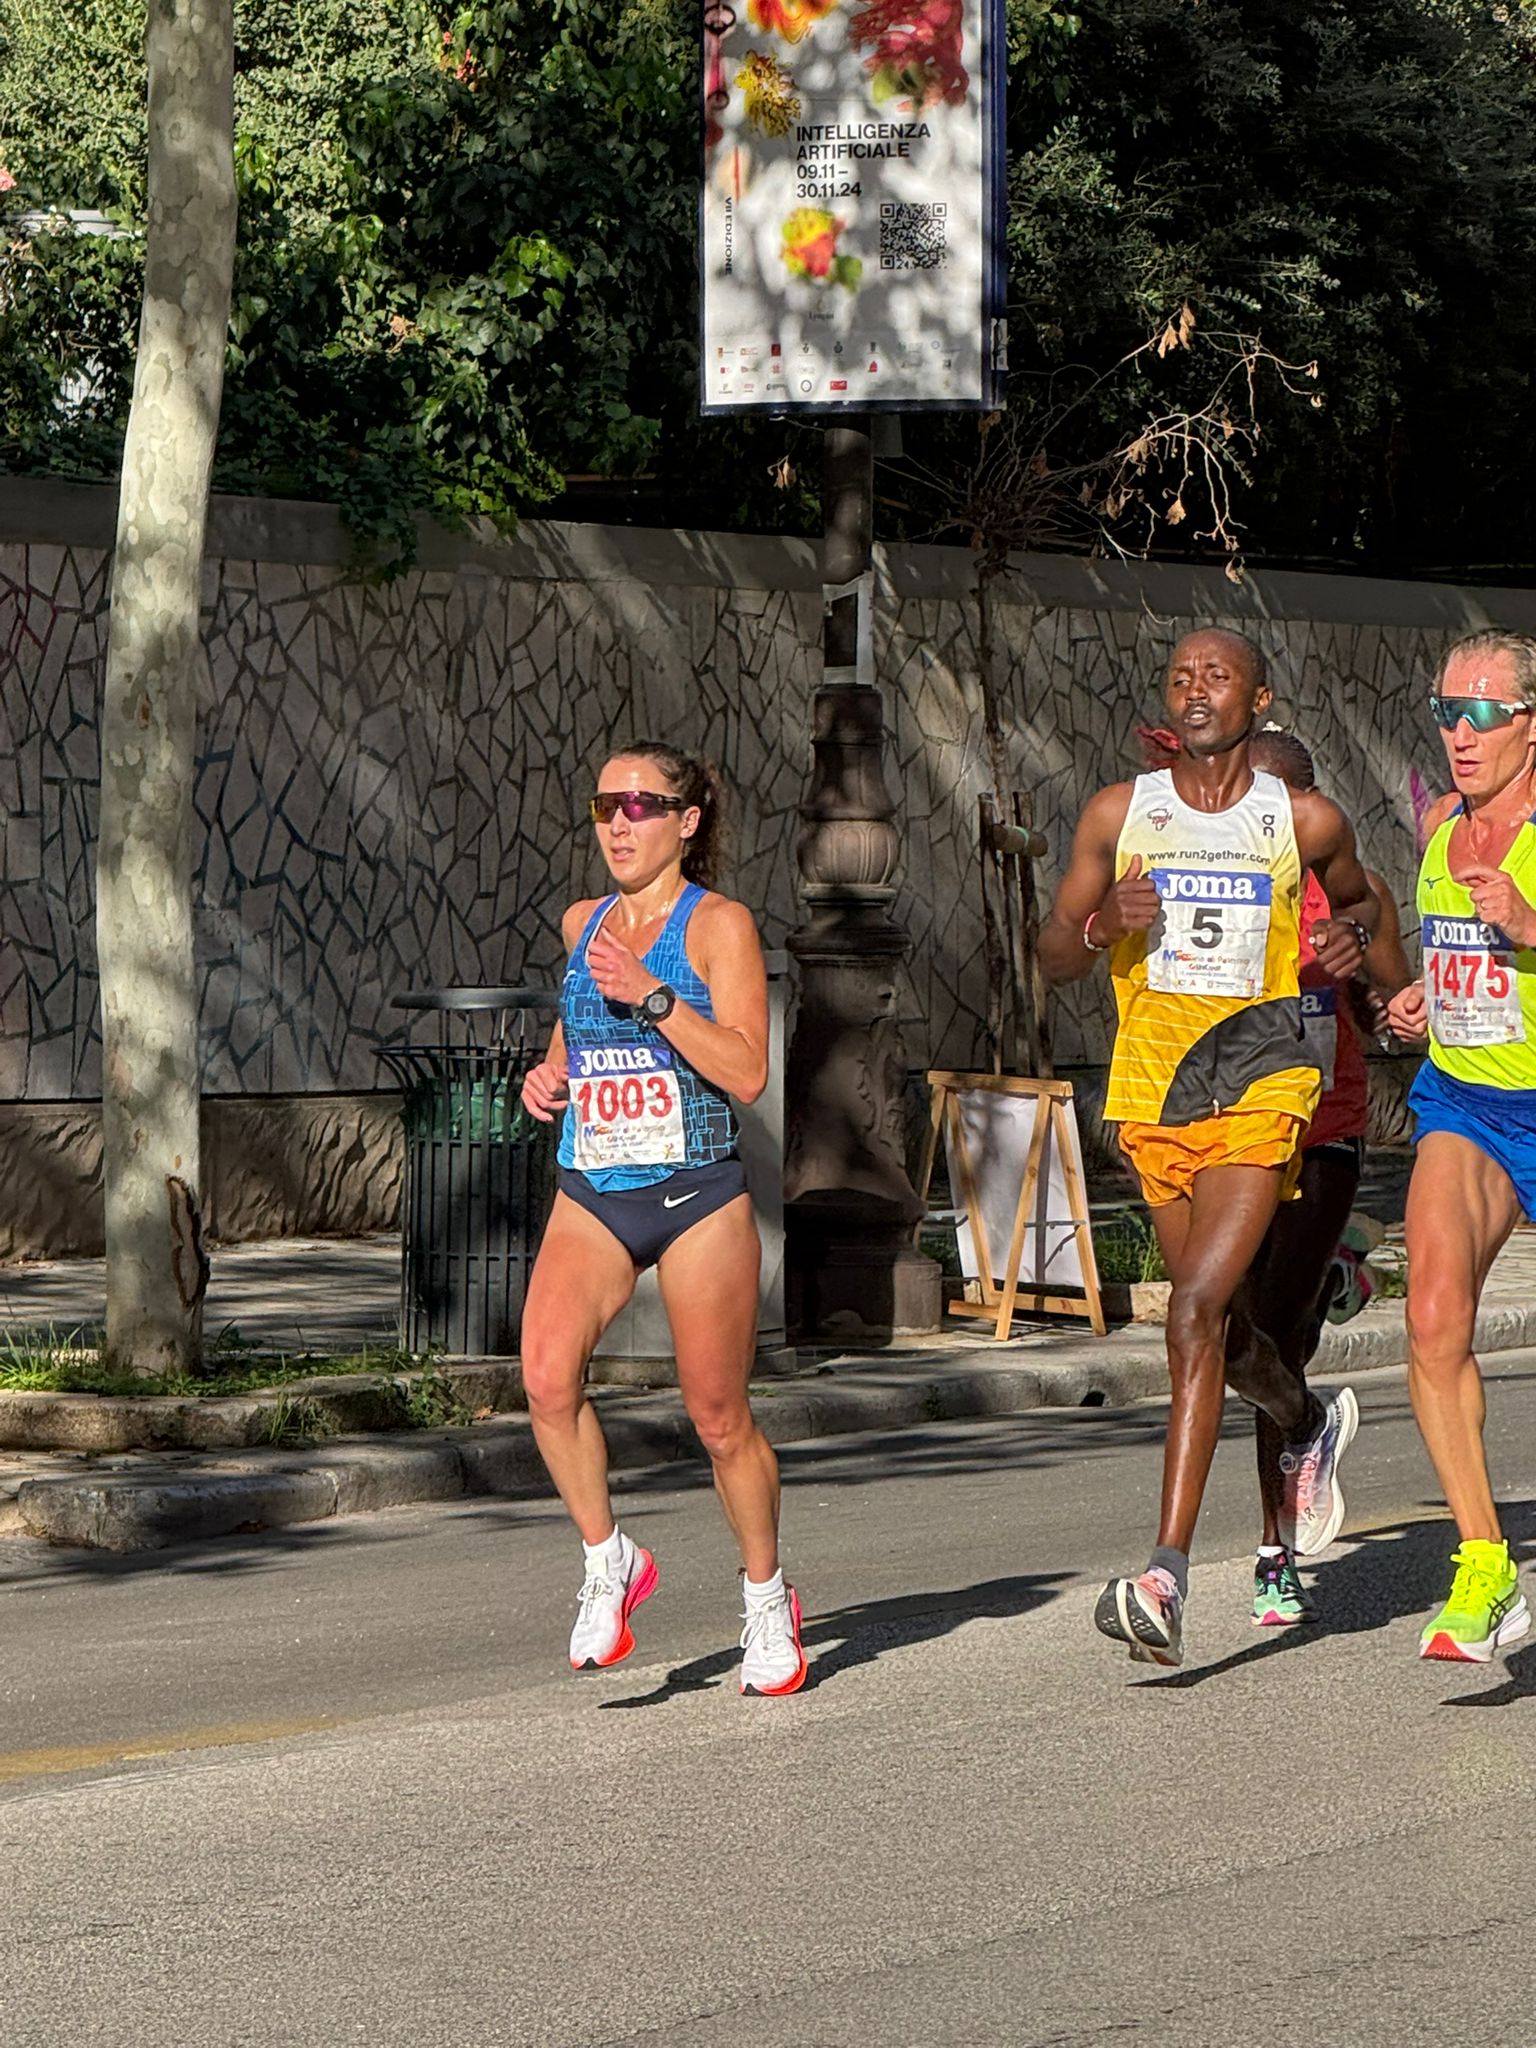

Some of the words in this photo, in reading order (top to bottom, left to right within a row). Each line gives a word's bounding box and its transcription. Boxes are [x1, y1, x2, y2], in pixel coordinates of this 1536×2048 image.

[796, 123, 931, 142] INTELLIGENZA
[796, 142, 910, 161] ARTIFICIALE
[796, 182, 862, 198] 30.11.24
[725, 214, 733, 276] EDIZIONE
[1147, 849, 1271, 865] www.run2gether.com
[1190, 907, 1224, 949] 5
[1428, 951, 1510, 999] 1475
[577, 1075, 674, 1123] 1003
